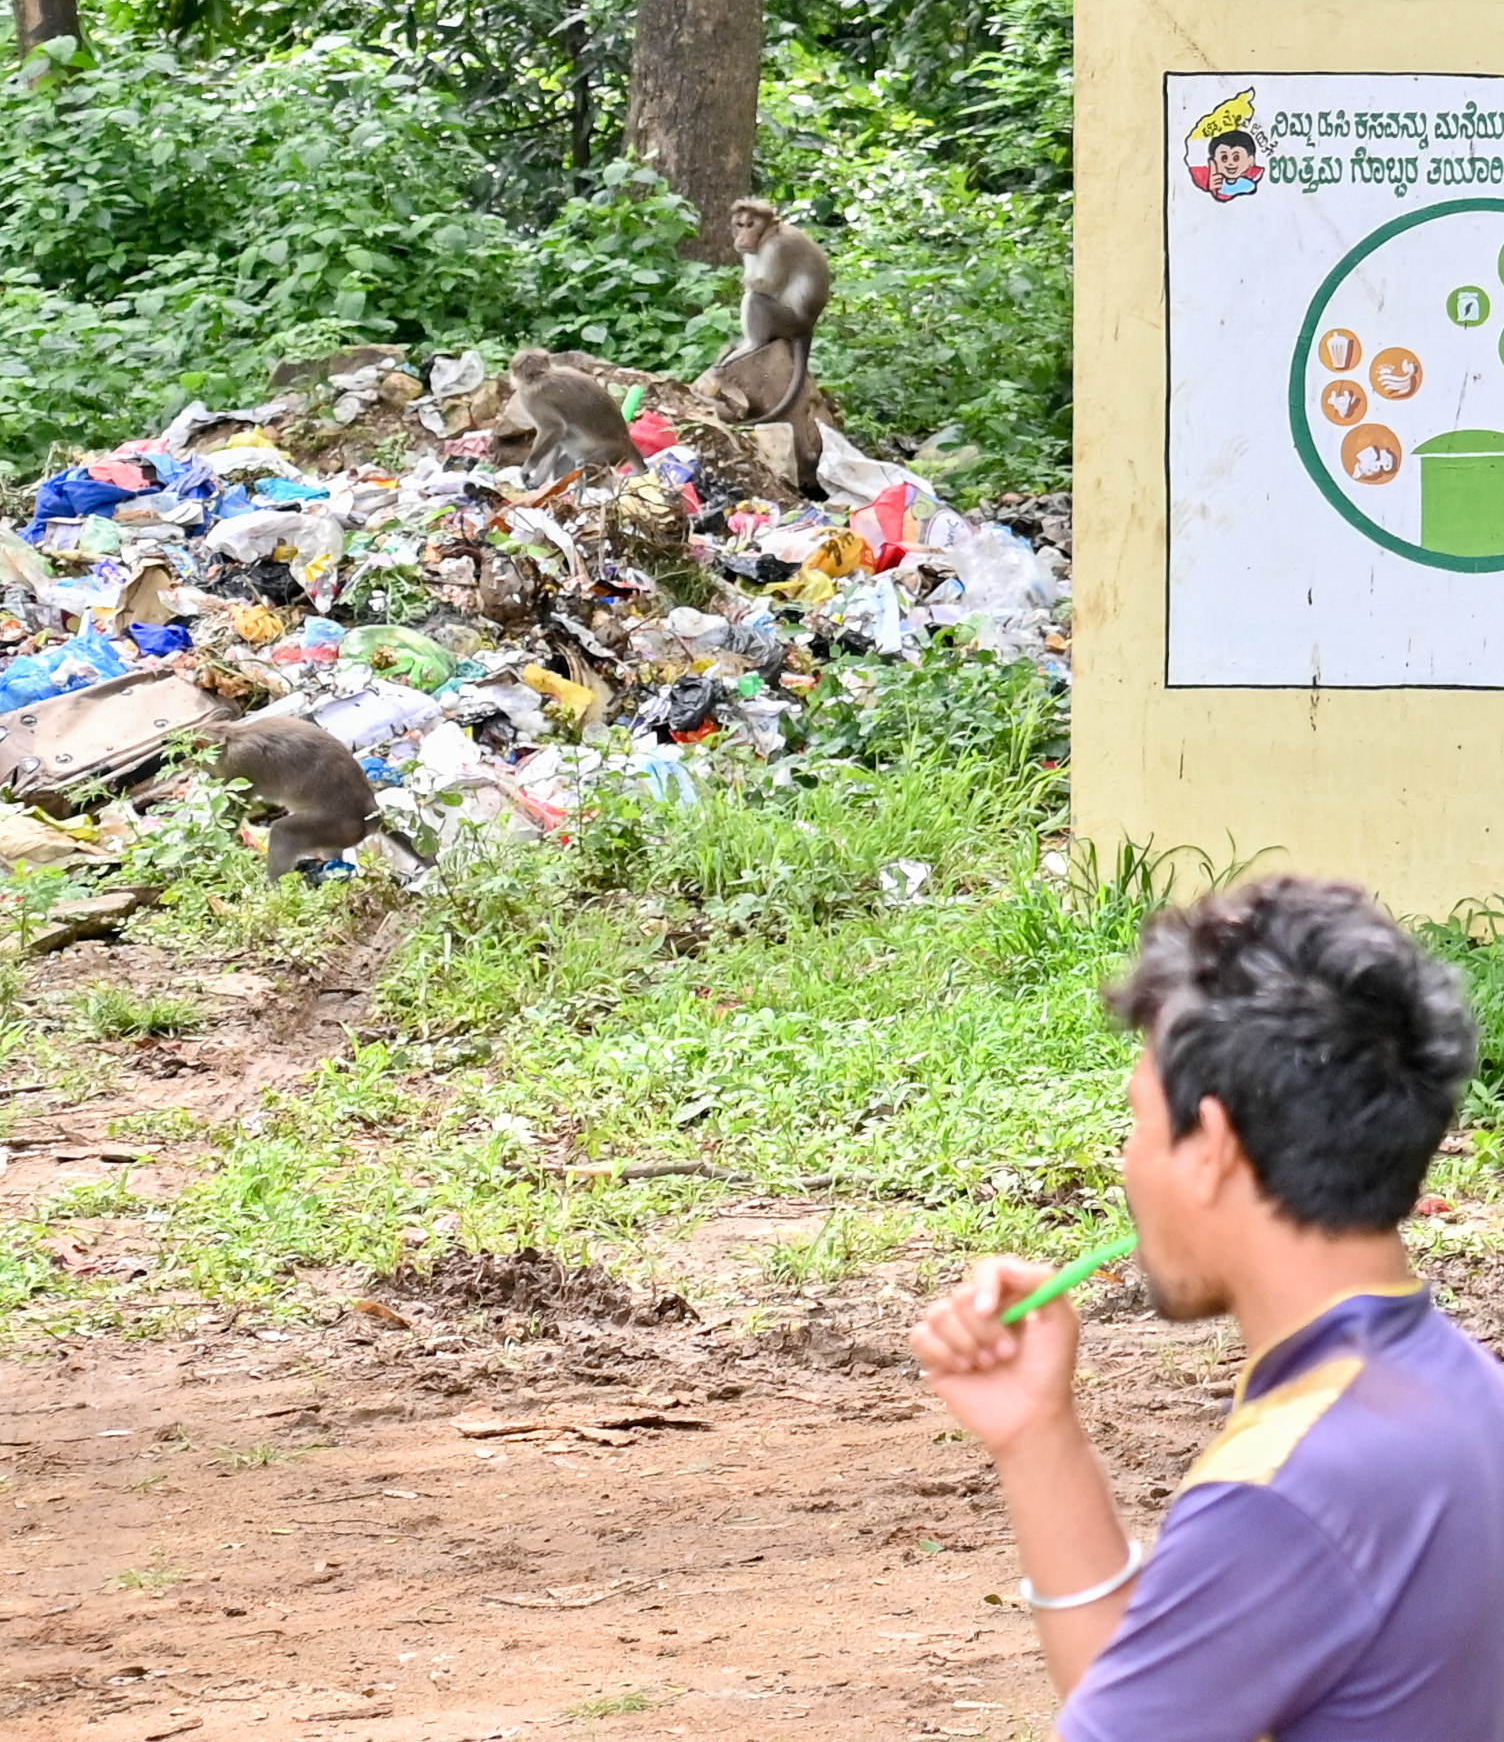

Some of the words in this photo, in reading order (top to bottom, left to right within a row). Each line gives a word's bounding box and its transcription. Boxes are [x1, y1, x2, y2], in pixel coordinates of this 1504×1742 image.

[1318, 109, 1351, 138] ಹಸಿ
[1354, 111, 1429, 150] ಕಸವನ್ನು
[1268, 156, 1343, 194] ಉತ್ತಮ
[1350, 146, 1419, 198] ಗೊಬ್ಬರ
